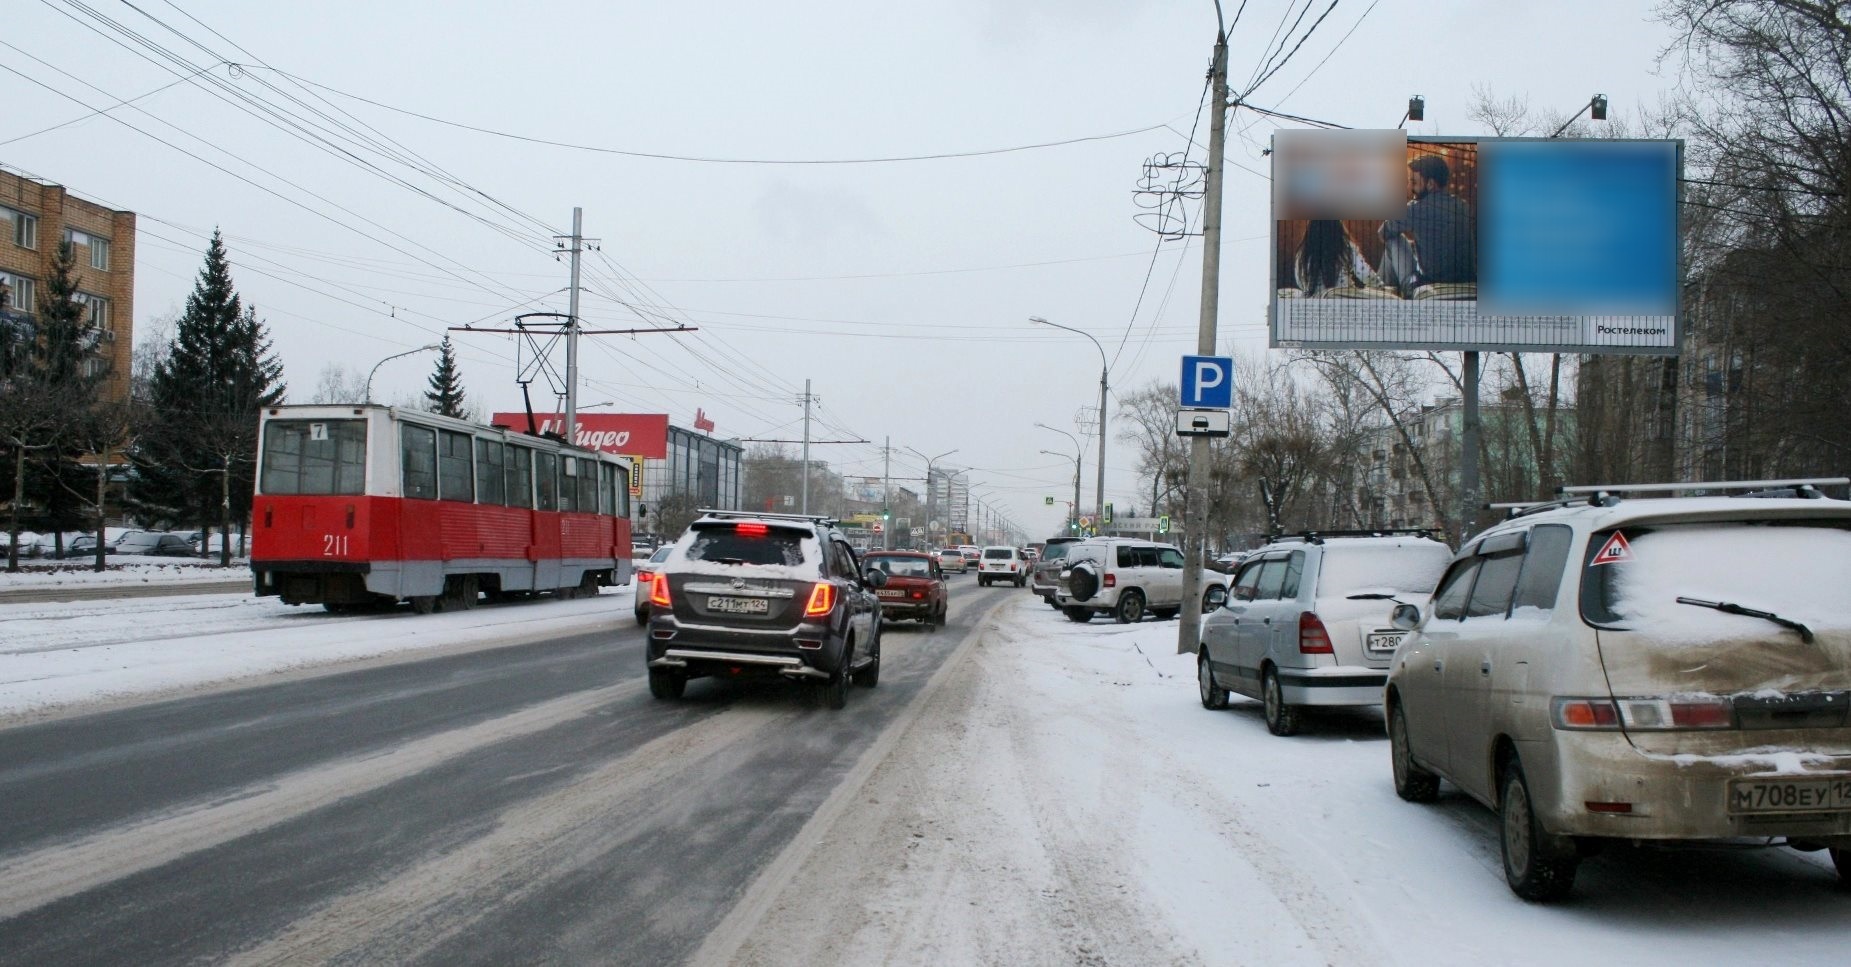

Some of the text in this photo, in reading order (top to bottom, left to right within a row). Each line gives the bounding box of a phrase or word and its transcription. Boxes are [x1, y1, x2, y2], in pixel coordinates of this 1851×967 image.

[1597, 325, 1666, 335] Ростелеком
[1194, 361, 1224, 402] P
[314, 424, 323, 439] 7
[323, 534, 349, 556] 211
[1608, 547, 1622, 557] Ш
[710, 599, 749, 609] С211МТ
[1737, 784, 1827, 807] М708ЕУ
